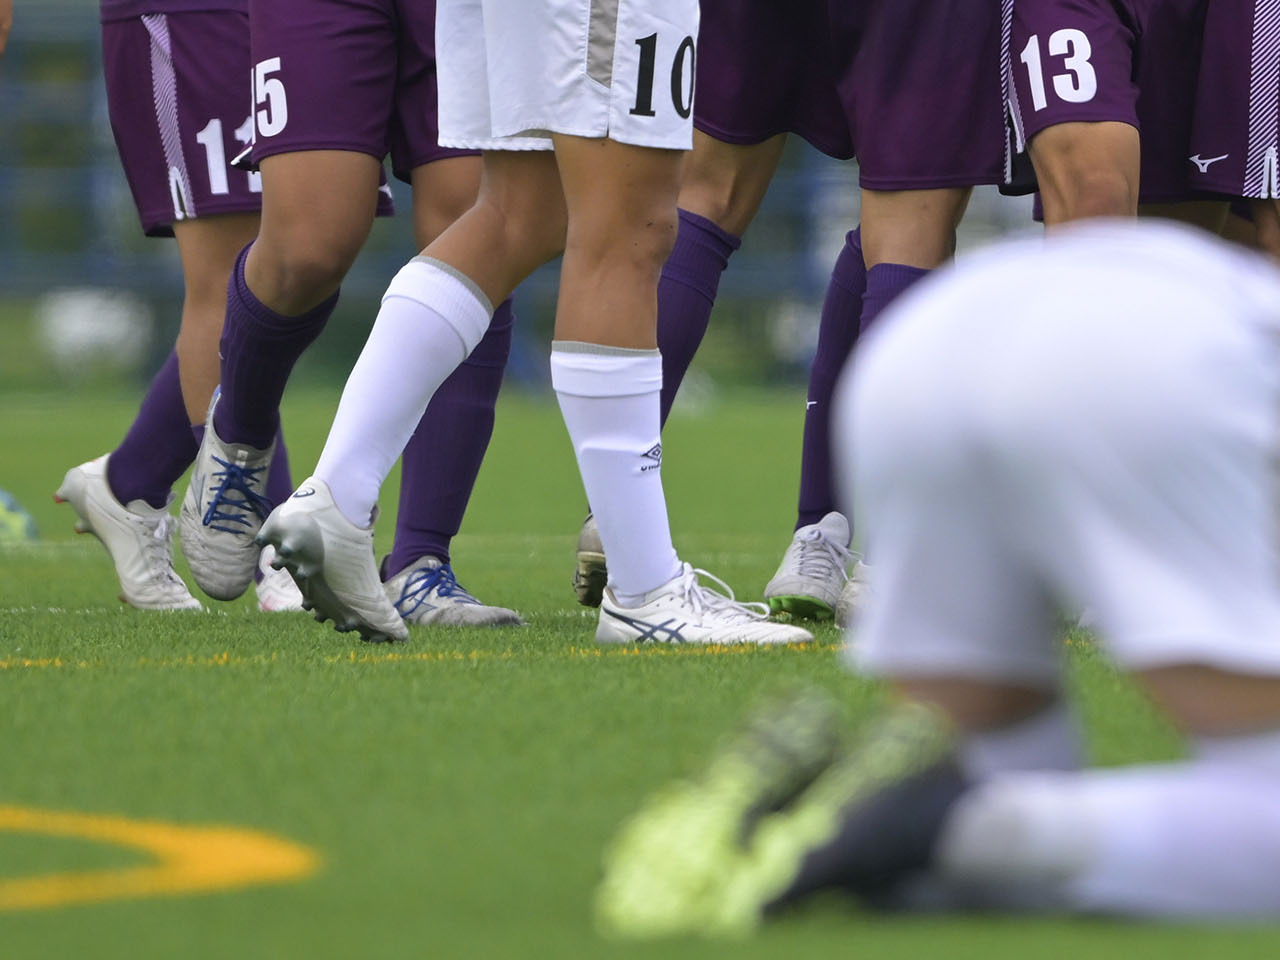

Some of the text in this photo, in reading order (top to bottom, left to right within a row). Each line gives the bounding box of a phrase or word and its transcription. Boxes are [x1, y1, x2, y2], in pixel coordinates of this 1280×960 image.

[251, 57, 288, 137] 5
[629, 32, 695, 119] 10
[1020, 29, 1097, 112] 13
